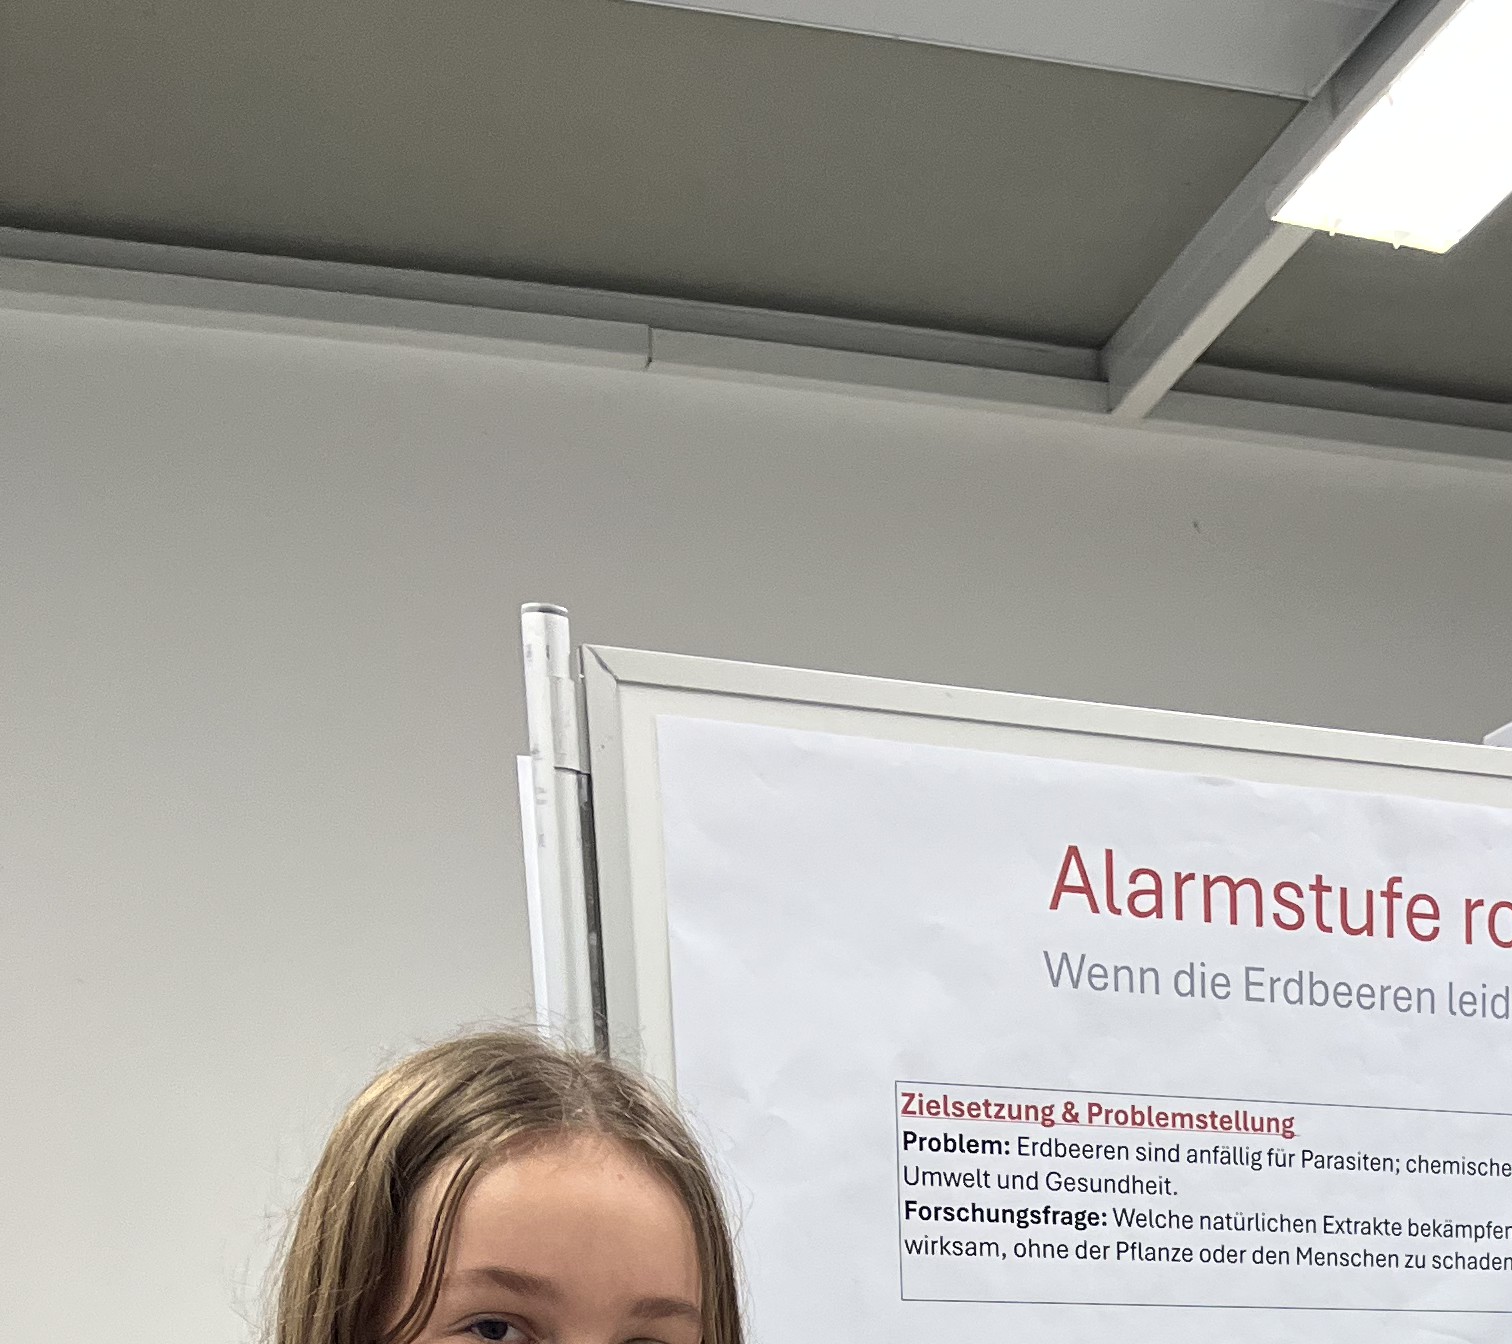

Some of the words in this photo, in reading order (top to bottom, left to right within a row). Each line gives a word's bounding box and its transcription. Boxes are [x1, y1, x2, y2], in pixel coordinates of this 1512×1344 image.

[1049, 844, 1441, 943] Alarmstufe
[1043, 950, 1160, 995] Wenn
[1173, 961, 1231, 1001] die
[1244, 965, 1435, 1015] Erdbeeren
[900, 1091, 1055, 1121] Zielsetzung
[1061, 1100, 1080, 1123] &
[1087, 1101, 1295, 1131] Problemstellung
[902, 1129, 1011, 1156] Problem:
[1017, 1135, 1129, 1161] Erdbeeren
[1135, 1141, 1181, 1163] sind
[1185, 1145, 1263, 1172] anfällig
[1265, 1147, 1297, 1169] für
[1301, 1149, 1401, 1176] Parasiten;
[1405, 1153, 1512, 1178] chemische
